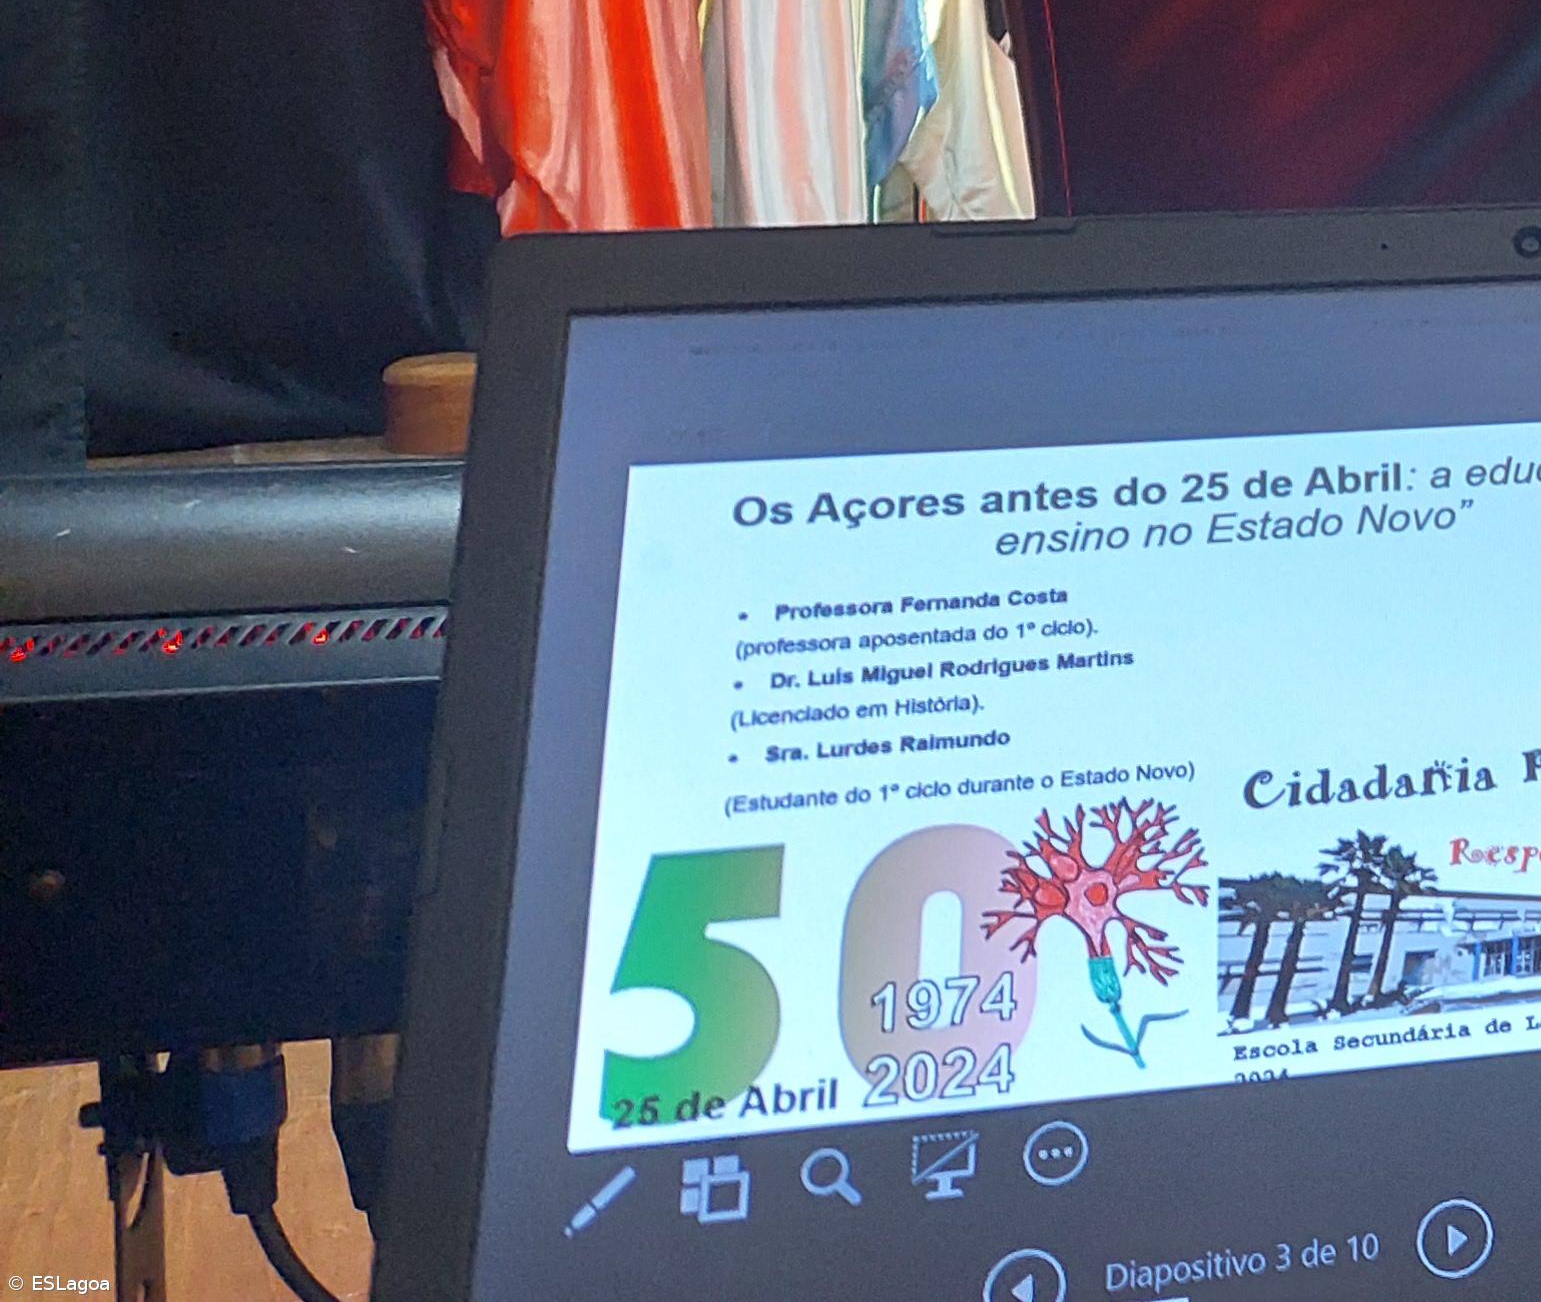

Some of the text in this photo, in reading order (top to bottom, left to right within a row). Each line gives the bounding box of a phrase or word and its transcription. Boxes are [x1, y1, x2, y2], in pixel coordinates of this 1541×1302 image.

[733, 495, 793, 527] Os
[807, 493, 965, 529] Açores
[980, 482, 1098, 514] antes
[1114, 477, 1167, 506] do
[1181, 472, 1228, 502] 25
[1243, 470, 1293, 498] de
[1305, 462, 1416, 497] Abril:
[1430, 466, 1451, 489] a
[996, 499, 1474, 555] ensino no Estado Novo”
[775, 588, 1067, 621] Professora Fernanda Costa
[736, 618, 1098, 661] (professora aposentada do 1º ciclo).
[771, 650, 1134, 689] Dr. Luís Miguel Rodrigues Martins
[731, 694, 984, 732] (Licenciado em História).
[765, 729, 1010, 762] Sra. Lurdes Raimundo
[725, 761, 1195, 818] (Estudante do 1º ciclo durante o Estado Novo)
[1243, 757, 1497, 809] Cidadania
[600, 823, 1038, 1122] 50
[871, 972, 1018, 1033] 1974
[1233, 1039, 1318, 1061] Escola
[1334, 1023, 1471, 1050] Secundária
[1485, 1018, 1511, 1034] de
[863, 1044, 1015, 1107] 2024
[613, 1077, 839, 1130] 25 de Abril
[1106, 1233, 1378, 1292] Diapositivo 3 de 10
